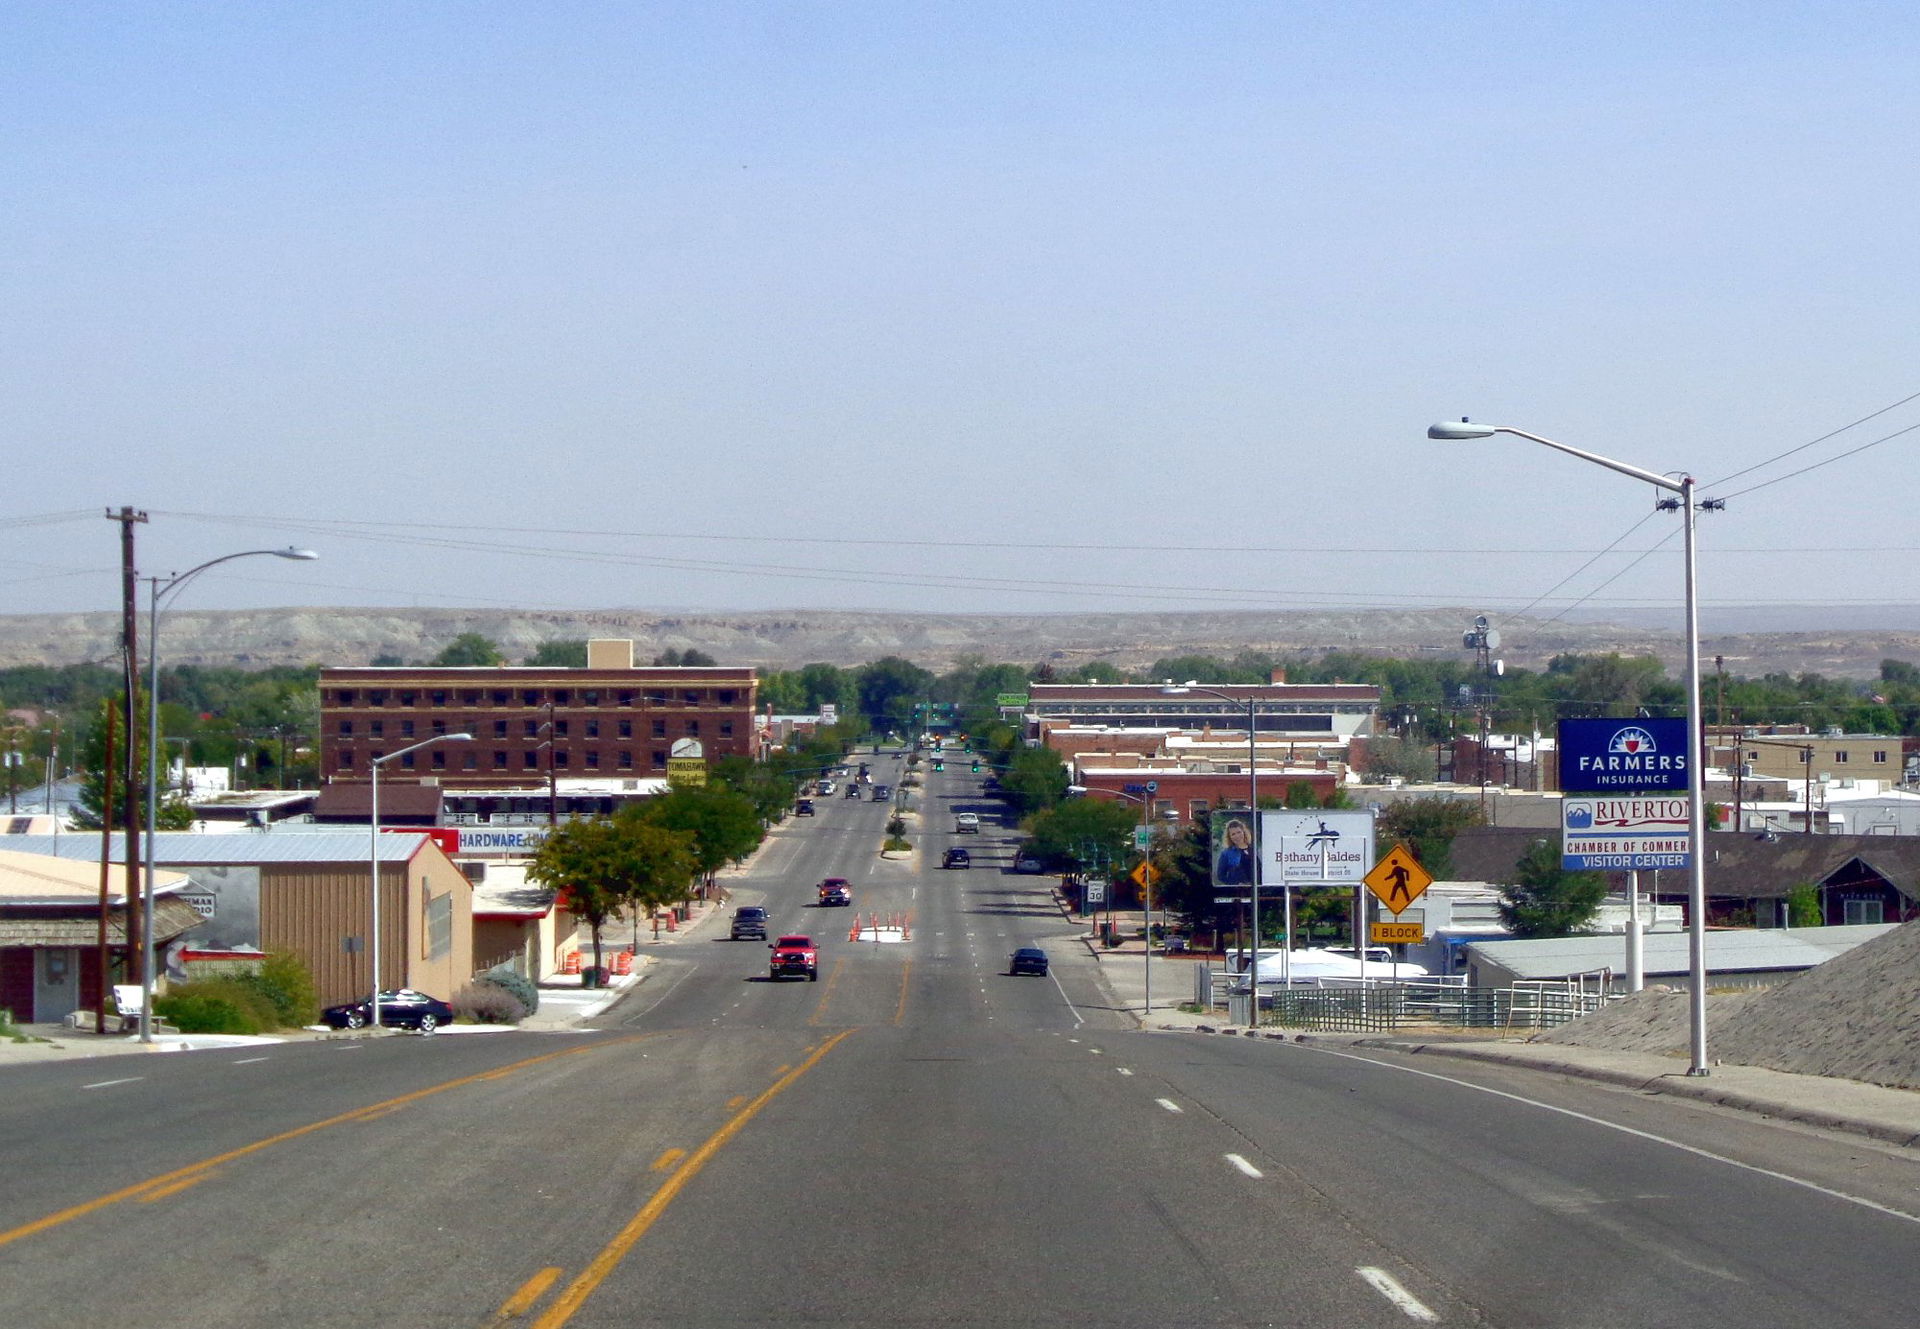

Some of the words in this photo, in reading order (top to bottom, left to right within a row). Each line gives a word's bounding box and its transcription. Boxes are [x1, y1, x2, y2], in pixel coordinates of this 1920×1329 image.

[1579, 755, 1686, 771] FARMERS
[1597, 775, 1669, 784] INSURANCE
[459, 833, 523, 847] HARDWARE
[1567, 842, 1617, 853] CHAMBER
[1623, 842, 1636, 852] OF
[1642, 841, 1689, 852] COMMER
[1275, 851, 1320, 864] Bethany
[1583, 855, 1631, 867] VISITOR
[1635, 855, 1684, 866] CENTER
[1089, 892, 1102, 900] 30
[1381, 928, 1419, 938] BLOCK
